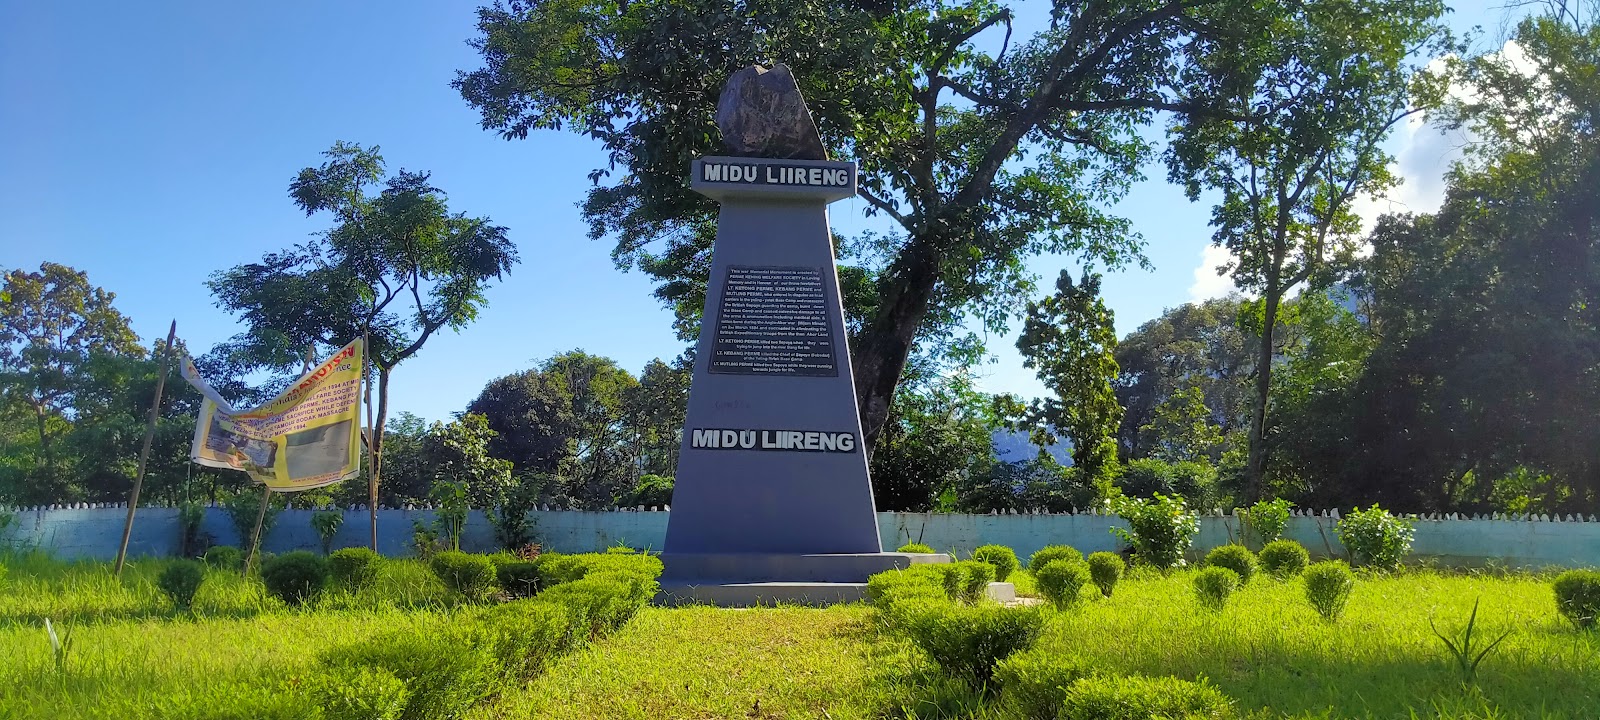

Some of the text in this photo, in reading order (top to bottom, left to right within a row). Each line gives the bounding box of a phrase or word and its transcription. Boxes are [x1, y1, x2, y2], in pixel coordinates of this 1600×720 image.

[704, 164, 848, 186] MIDU LIIRENG
[692, 430, 854, 451] MIDU LIIRENG
